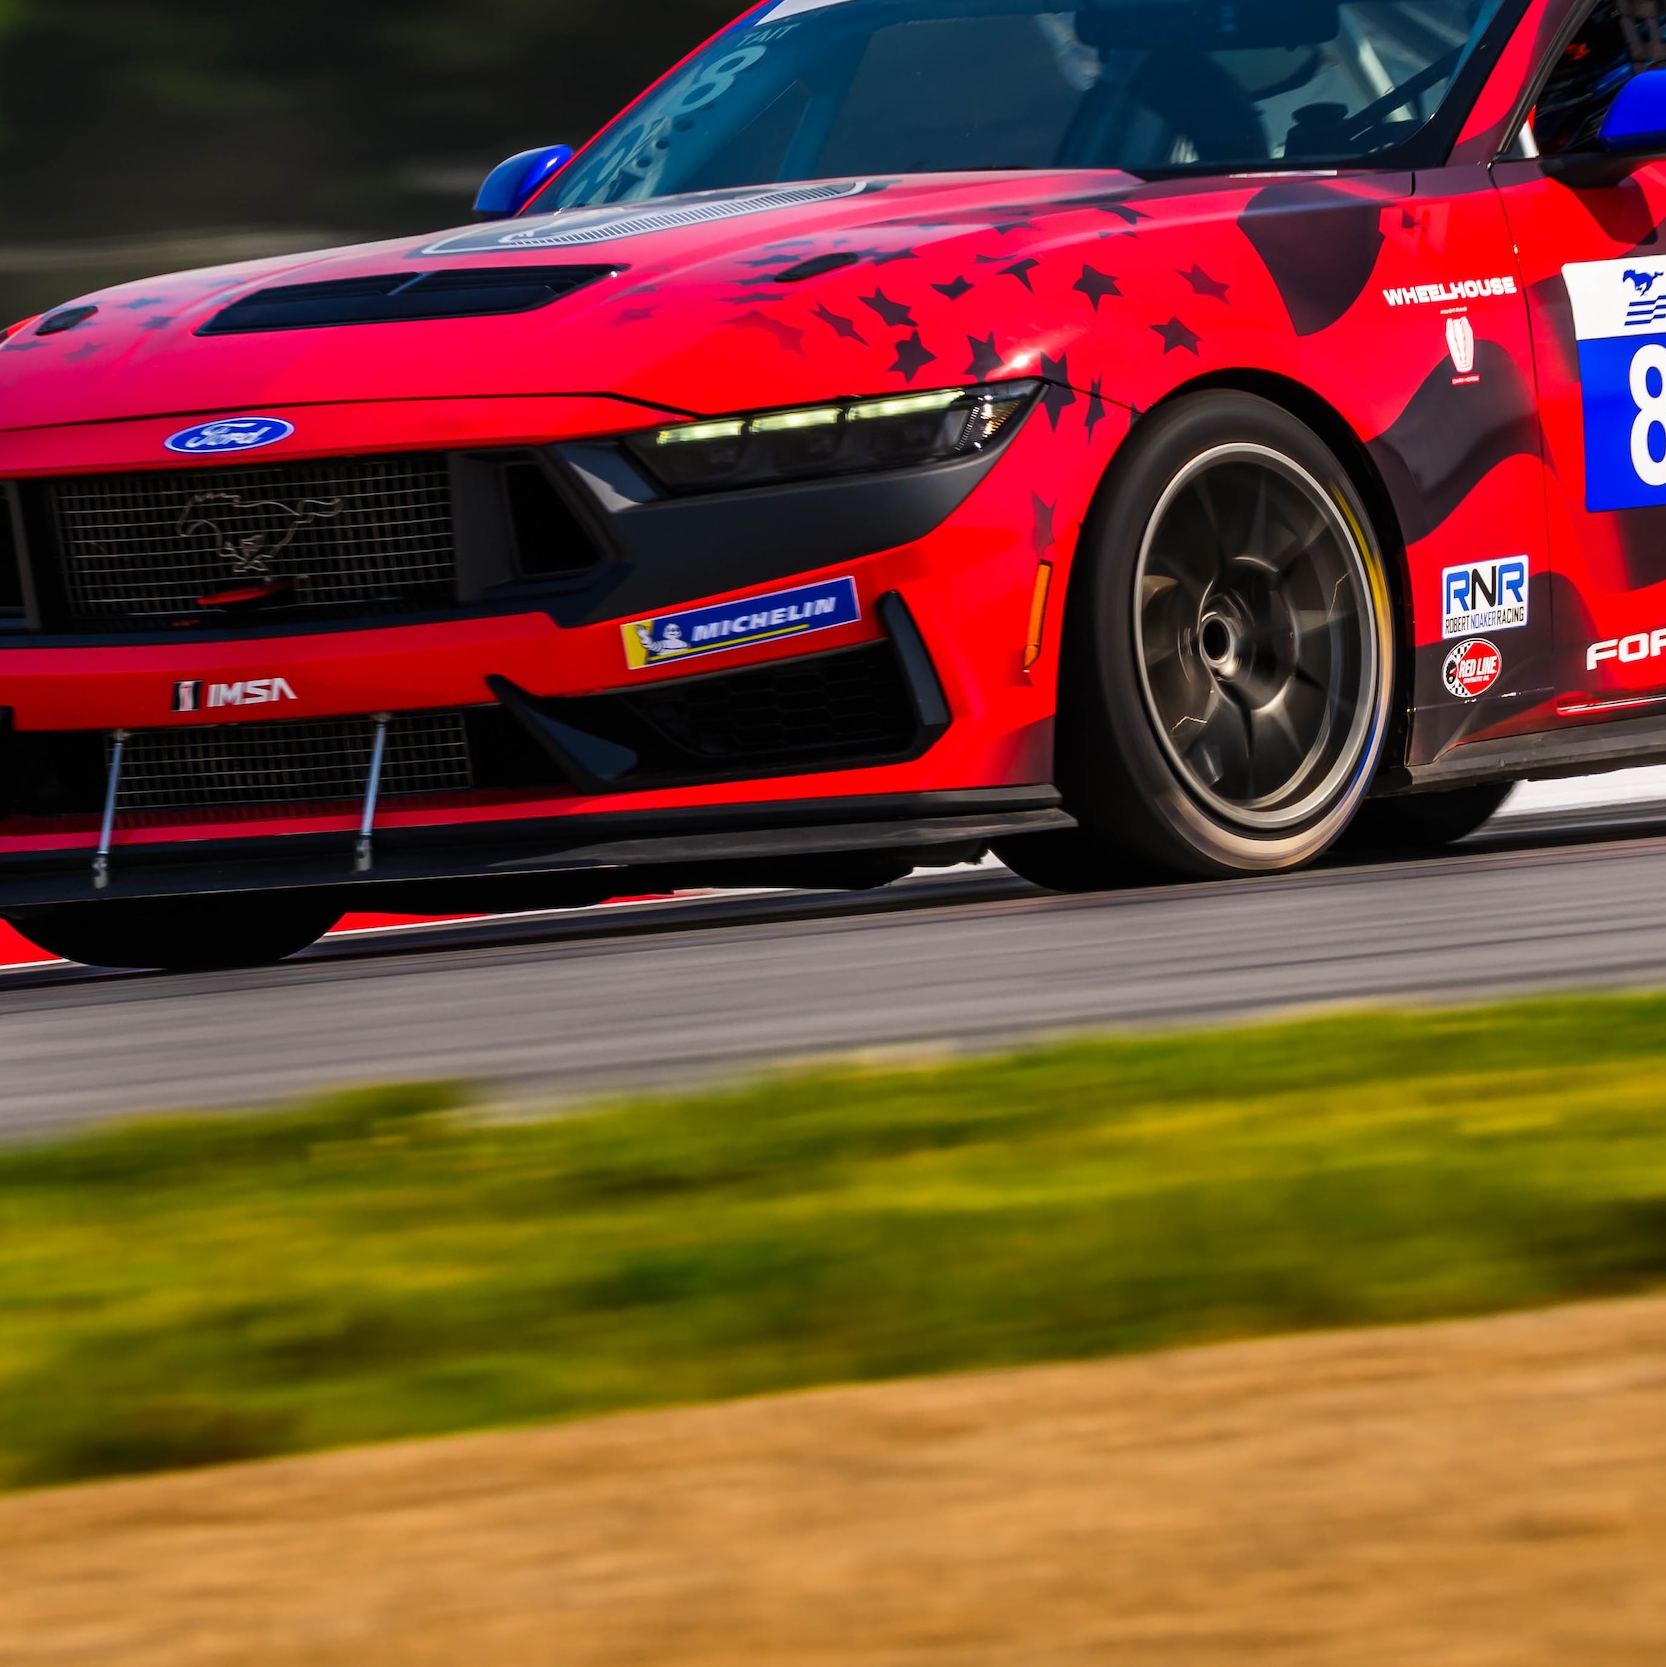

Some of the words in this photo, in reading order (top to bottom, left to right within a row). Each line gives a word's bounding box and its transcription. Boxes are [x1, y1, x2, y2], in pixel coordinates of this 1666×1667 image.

[735, 22, 802, 48] TAIT
[659, 44, 767, 116] 8
[1382, 275, 1518, 306] WHEELHOUSE
[184, 422, 273, 449] Ford
[1446, 562, 1524, 615] RNR
[691, 596, 837, 643] MICHELIN
[1445, 615, 1470, 634] ROBERT
[1470, 610, 1497, 630] NOAKER
[1496, 606, 1524, 626] RACING
[1458, 658, 1477, 678] RED
[1476, 655, 1498, 676] LINE
[206, 677, 298, 707] IMSA
